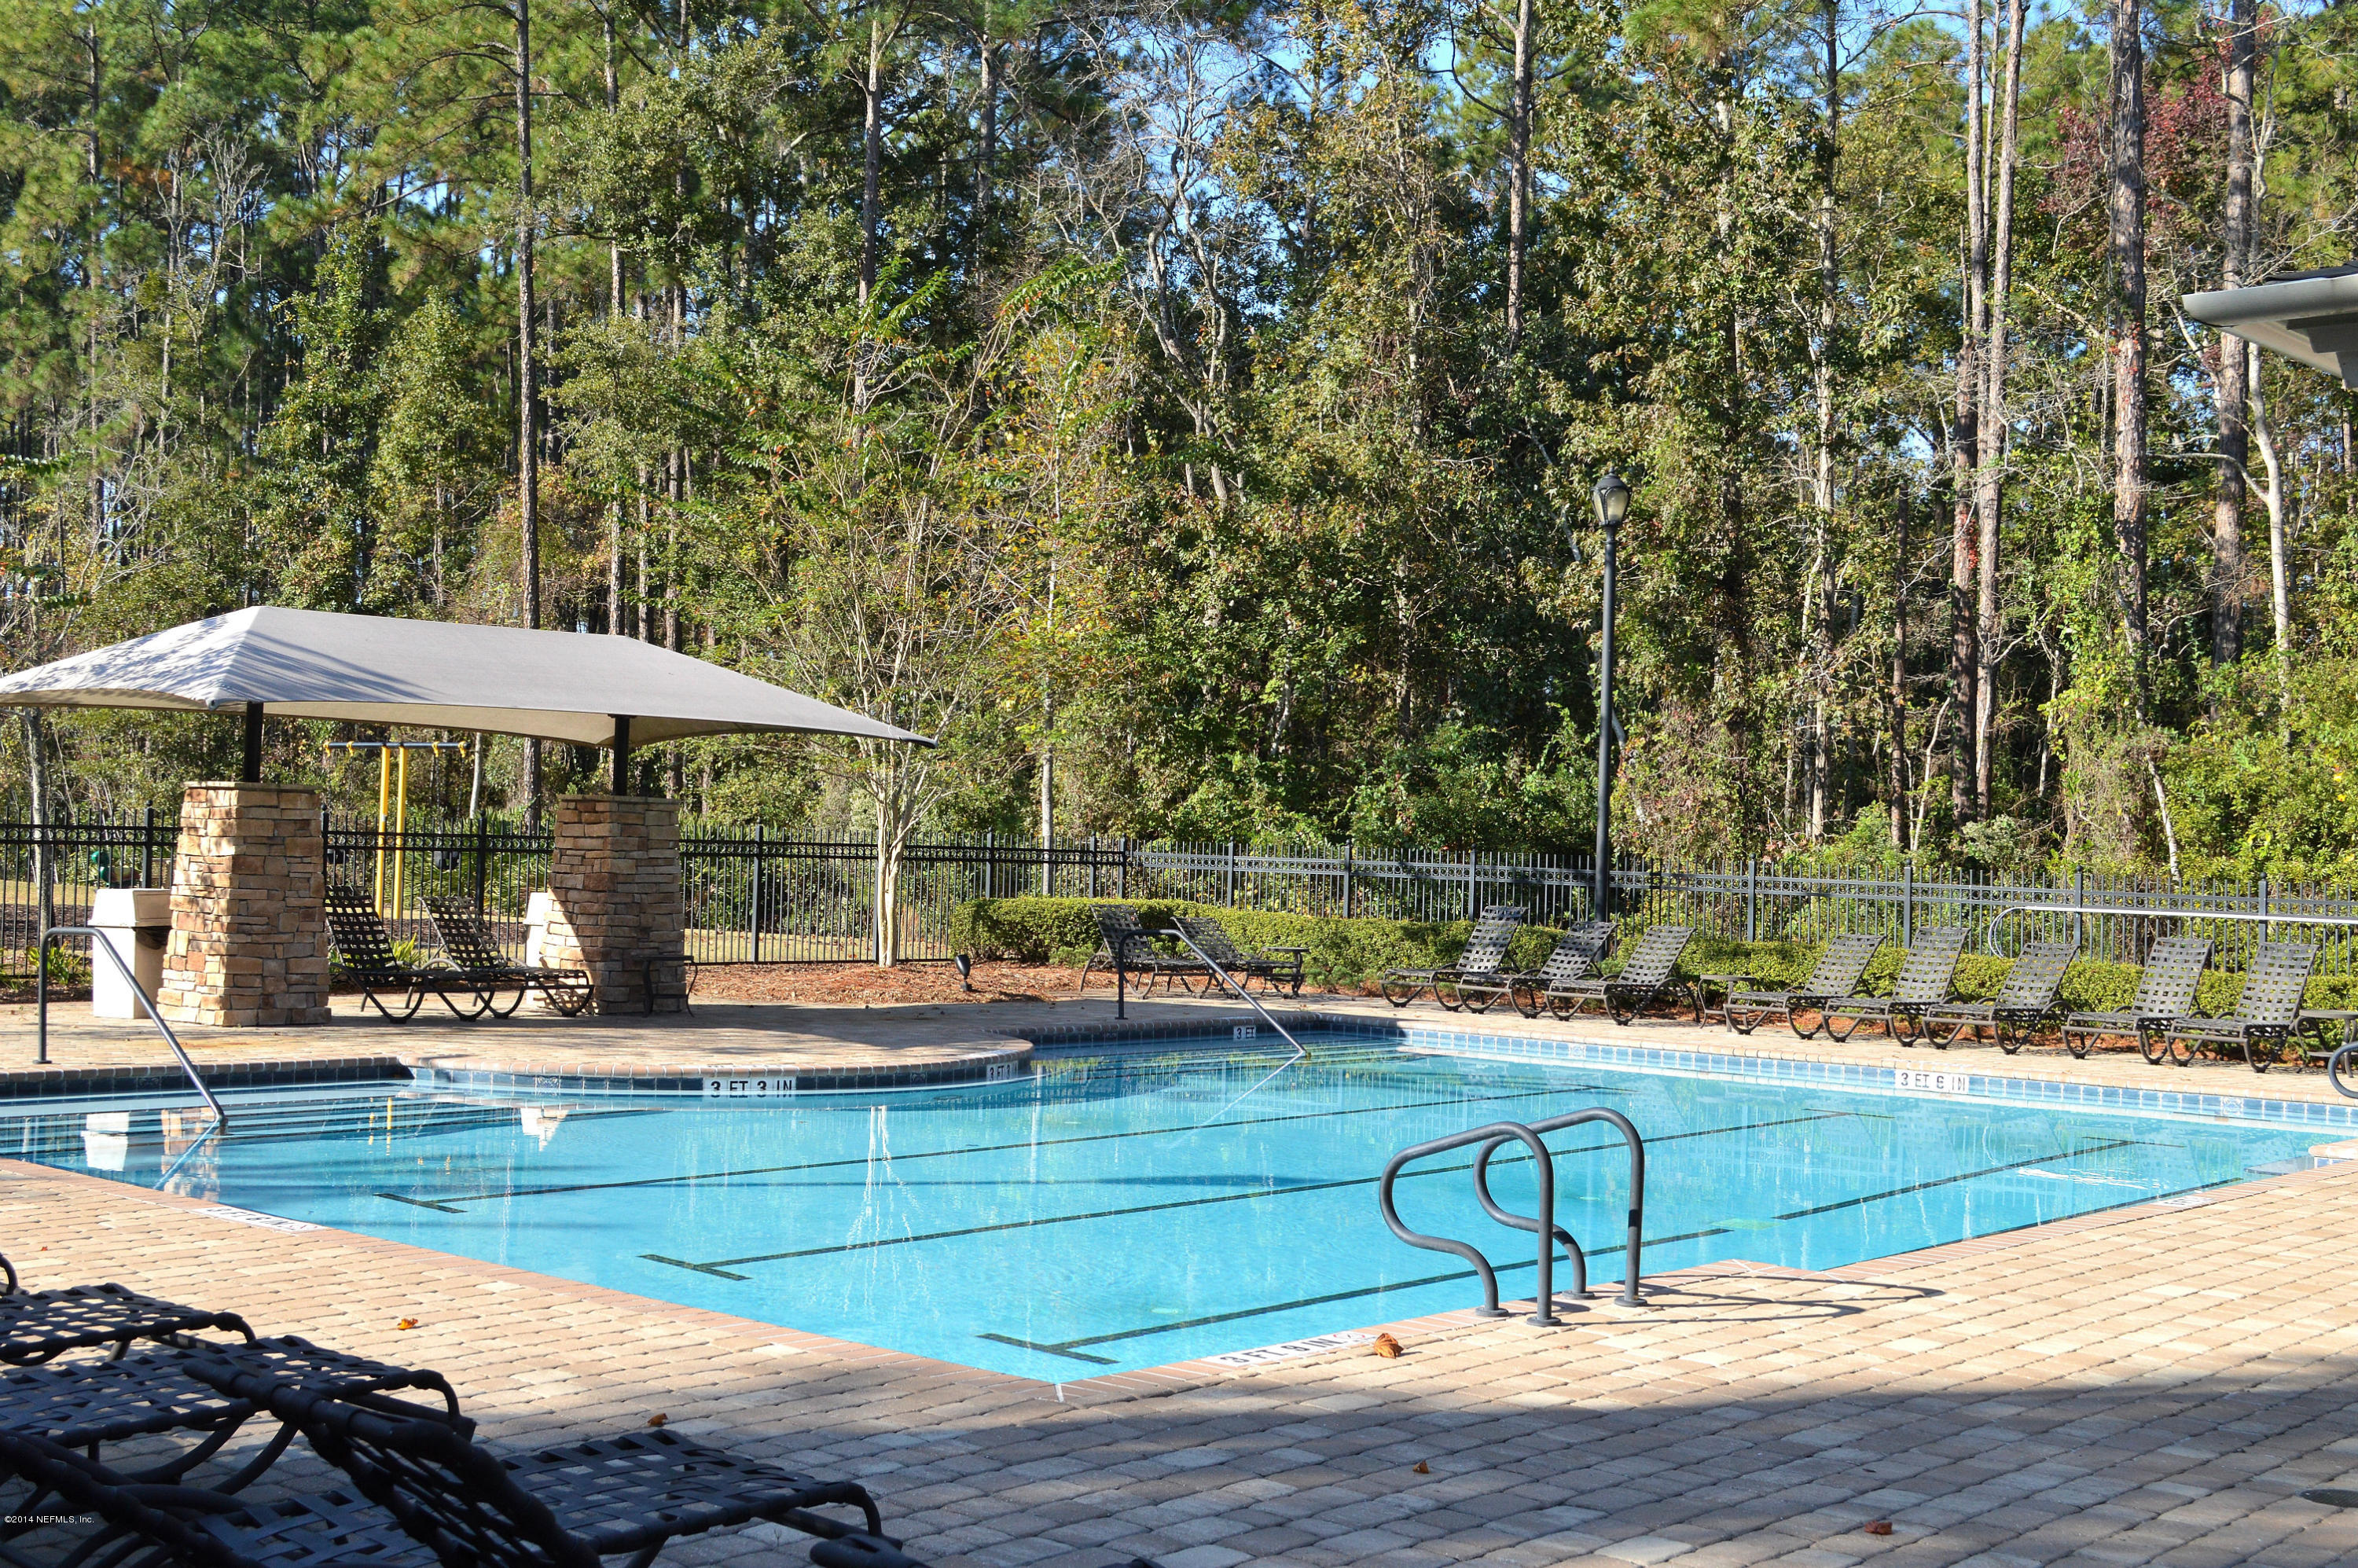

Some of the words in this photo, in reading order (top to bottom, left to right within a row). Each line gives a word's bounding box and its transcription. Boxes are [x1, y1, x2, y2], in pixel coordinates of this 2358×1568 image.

[1236, 1027, 1242, 1039] 3
[1901, 1072, 1909, 1086] 3
[711, 1081, 721, 1098] 3
[777, 1080, 792, 1098] IN
